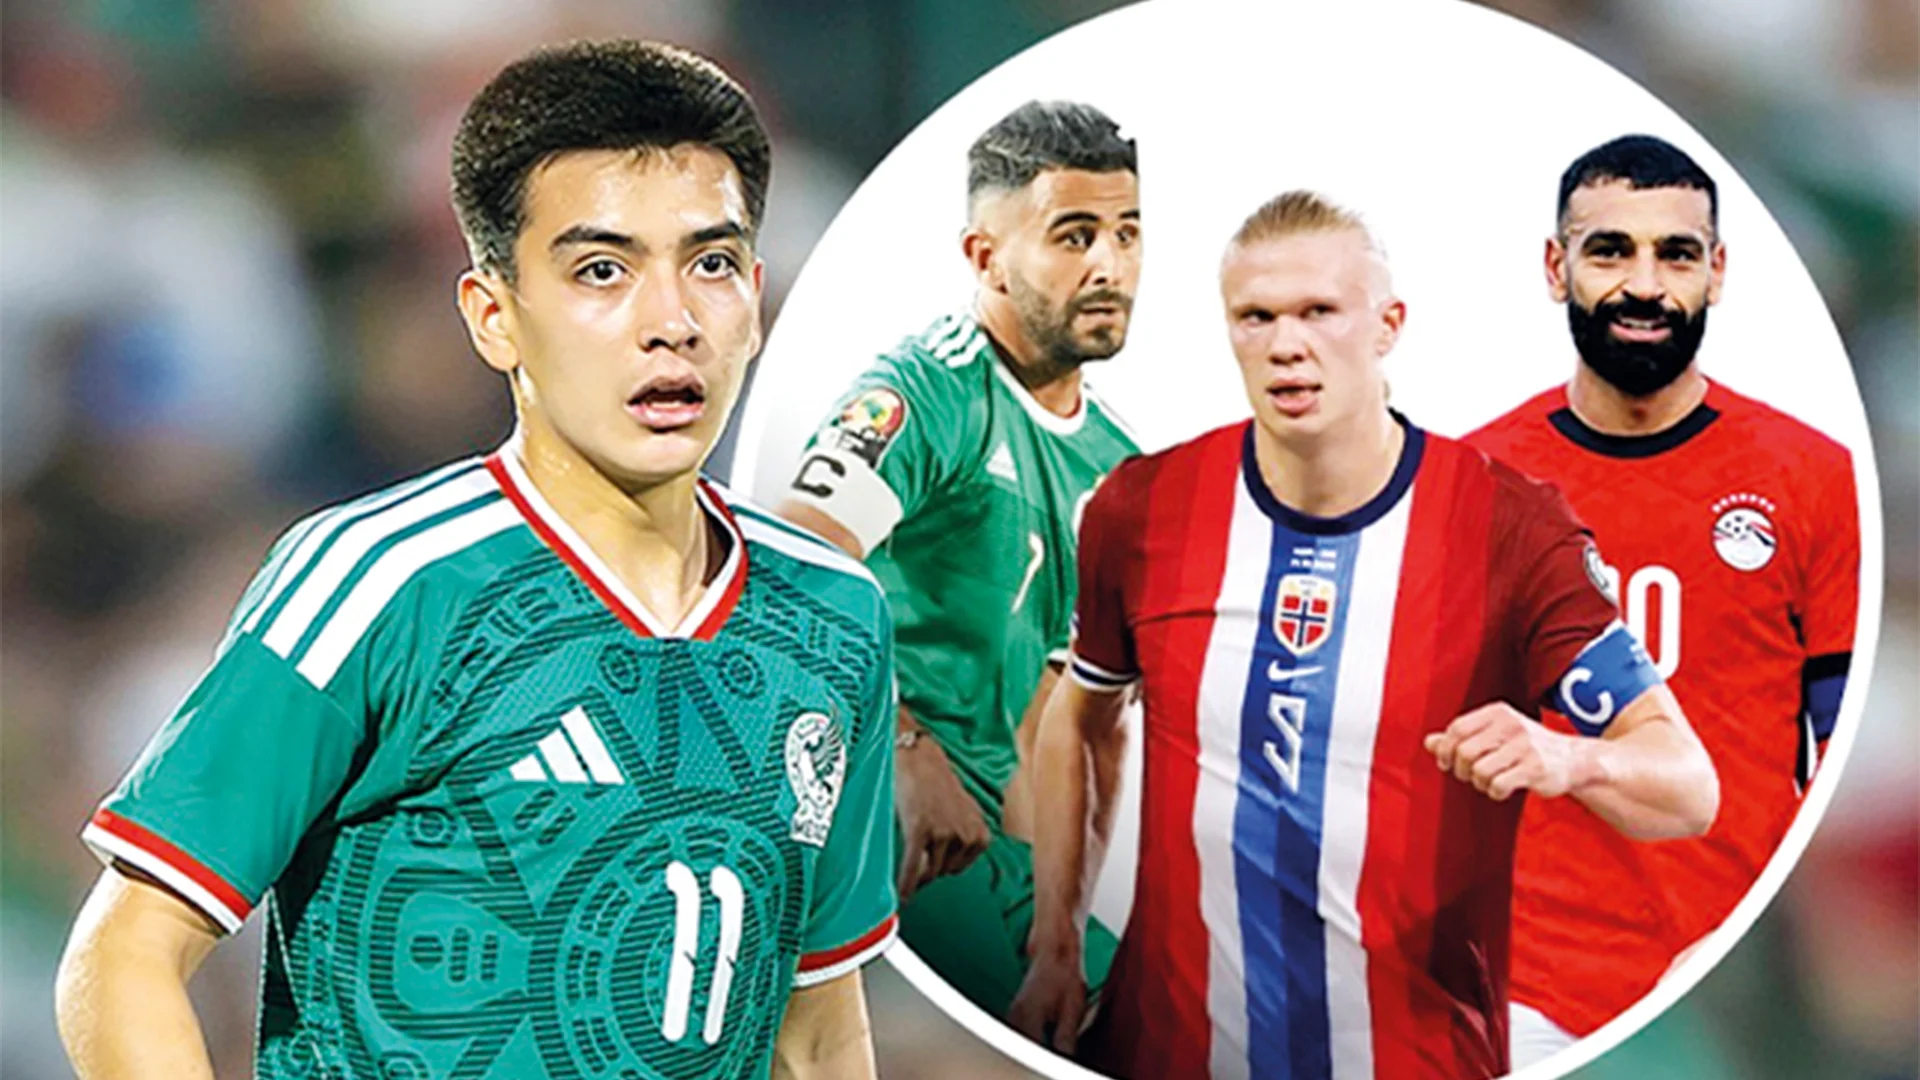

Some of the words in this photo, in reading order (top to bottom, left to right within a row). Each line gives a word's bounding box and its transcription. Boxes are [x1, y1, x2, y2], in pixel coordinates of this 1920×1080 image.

[791, 454, 846, 499] C
[1010, 532, 1045, 614] 7
[1602, 564, 1682, 682] 0
[1560, 666, 1614, 725] C
[660, 859, 745, 1045] 11
